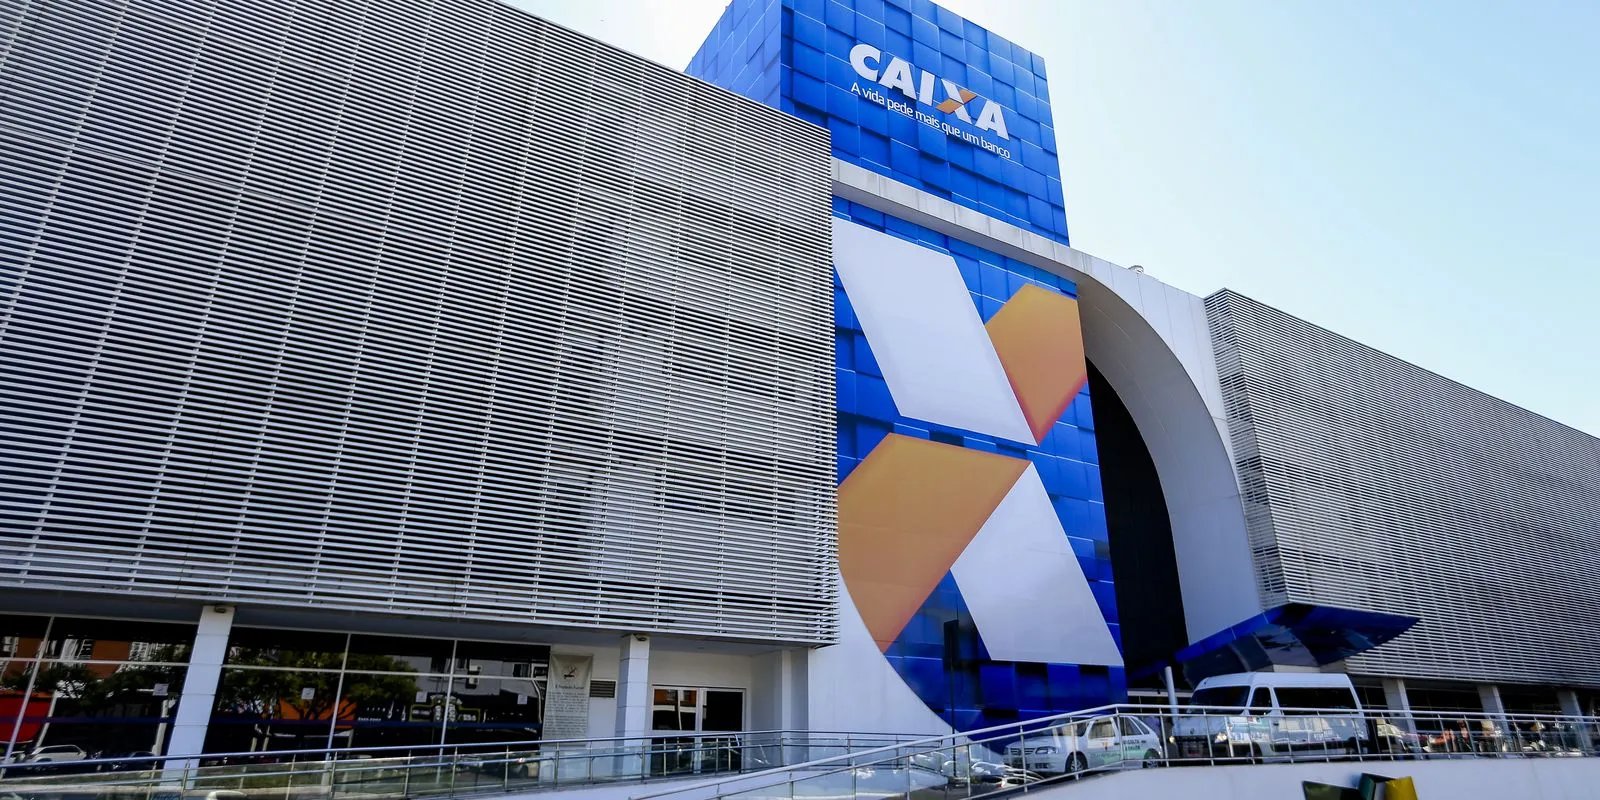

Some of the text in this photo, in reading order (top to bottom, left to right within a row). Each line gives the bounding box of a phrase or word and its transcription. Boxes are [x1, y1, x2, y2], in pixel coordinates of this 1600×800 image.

[849, 43, 1009, 141] CAIXA
[851, 82, 1011, 158] A vida pede mais que um banco
